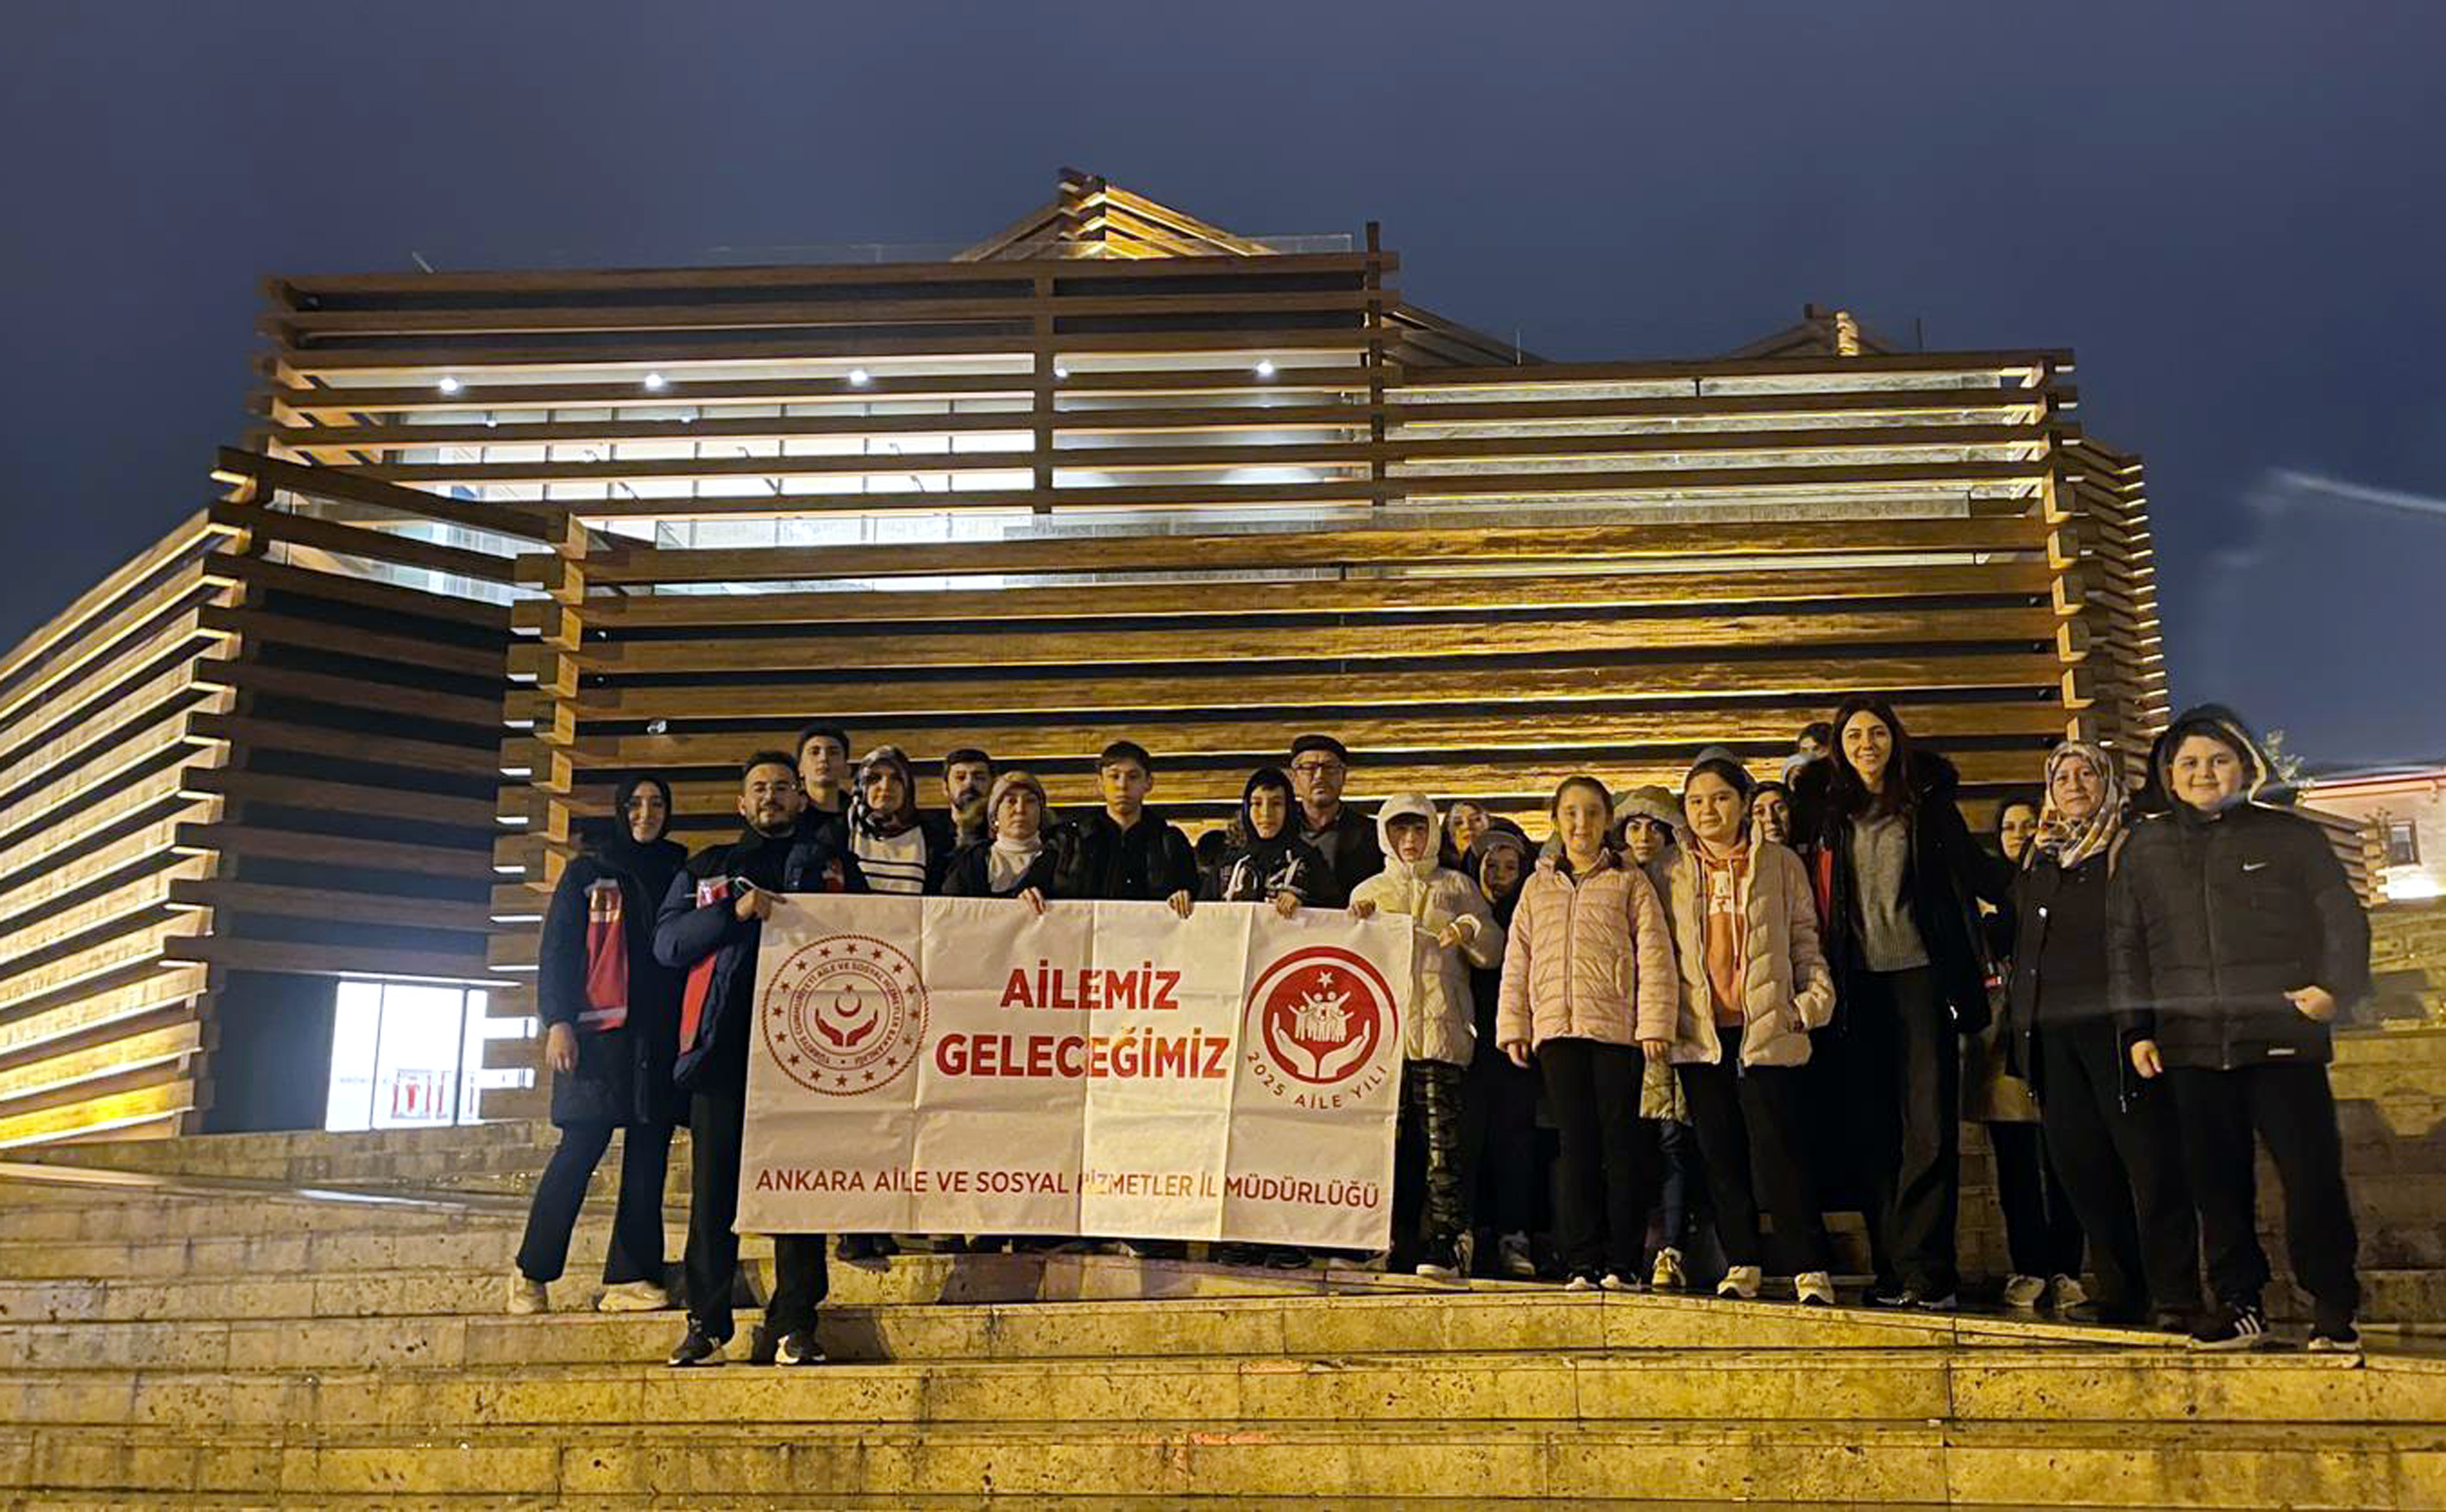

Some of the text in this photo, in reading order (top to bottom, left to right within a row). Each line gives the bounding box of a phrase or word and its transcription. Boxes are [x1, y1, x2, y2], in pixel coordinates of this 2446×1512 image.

[837, 962, 851, 971] VE
[1000, 959, 1181, 1010] AİLEMİZ
[935, 1026, 1230, 1078] GELECEĞİMİZ
[1247, 1051, 1387, 1110] 2025 AİLE YILI
[755, 1169, 865, 1192] ANKARA
[873, 1166, 928, 1192] AİLE
[936, 1170, 969, 1192] VE
[976, 1170, 1069, 1194] SOSYAL
[1199, 1170, 1217, 1197] İL
[1224, 1174, 1379, 1208] MÜDÜRLÜĞÜ
